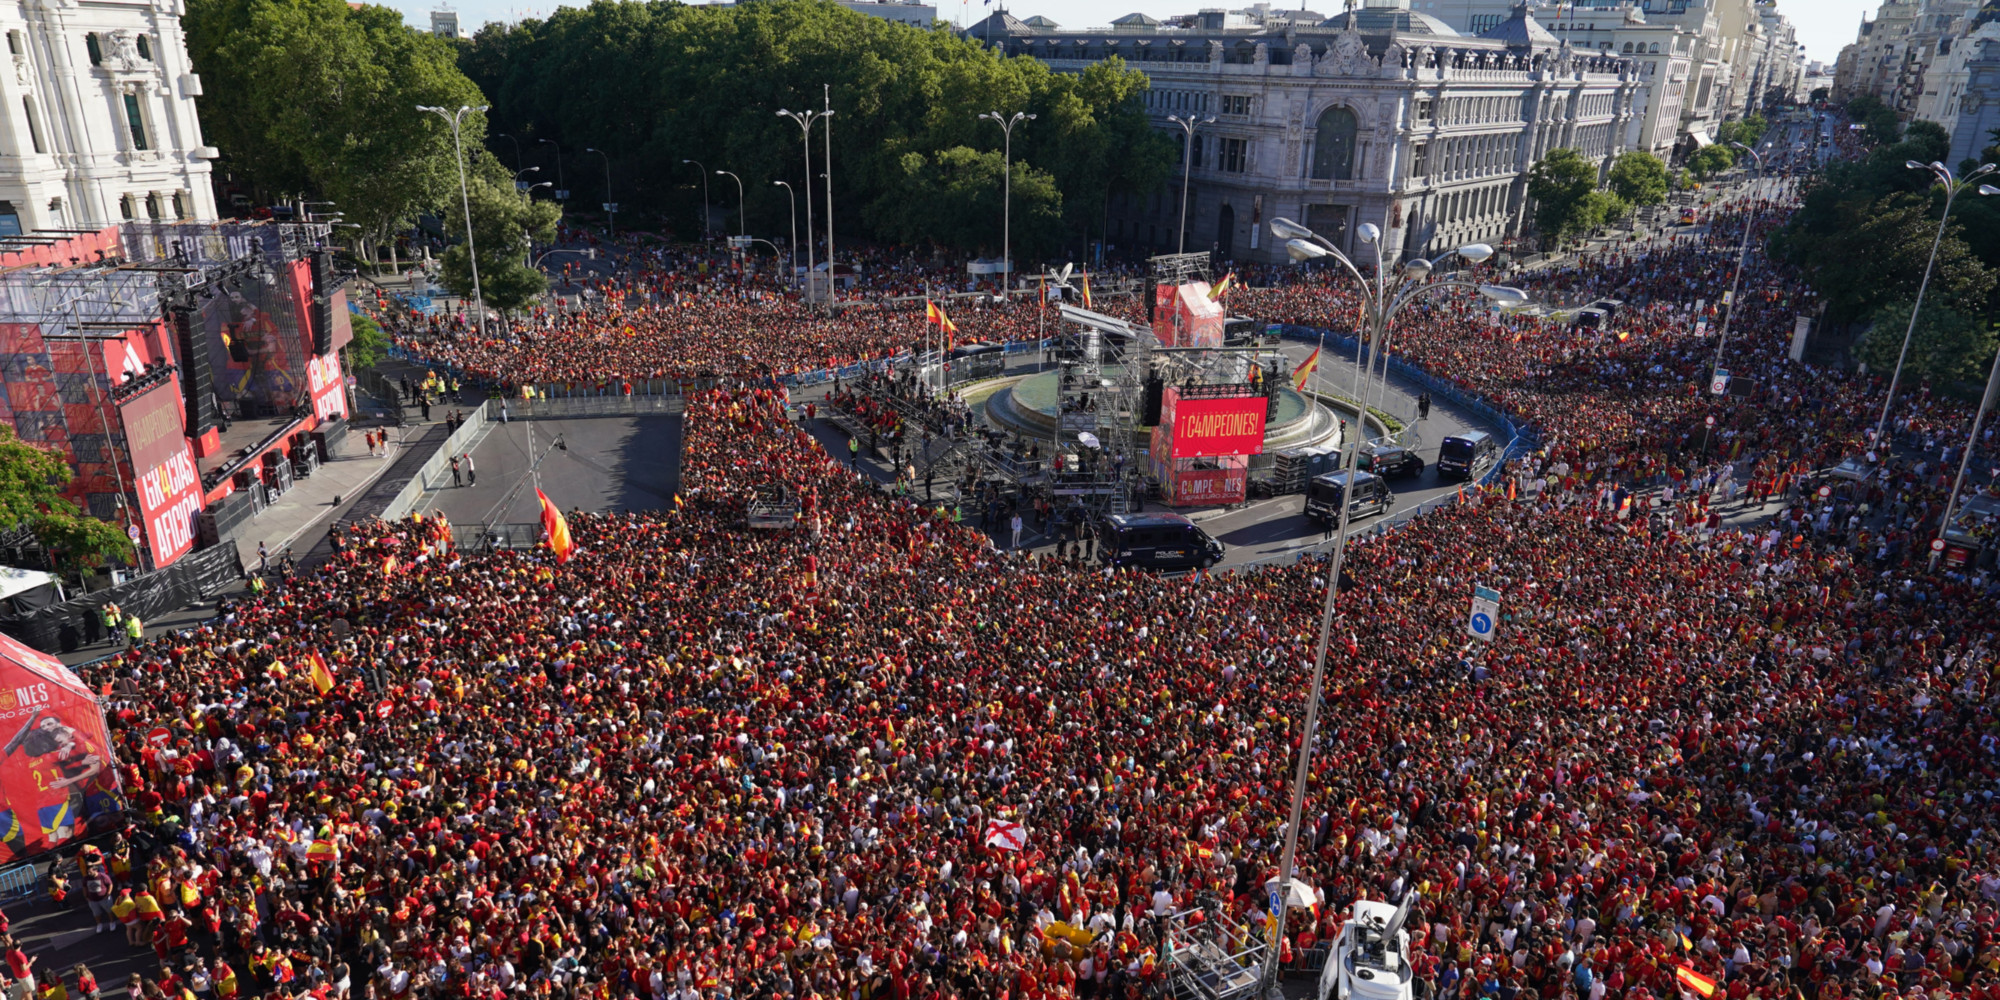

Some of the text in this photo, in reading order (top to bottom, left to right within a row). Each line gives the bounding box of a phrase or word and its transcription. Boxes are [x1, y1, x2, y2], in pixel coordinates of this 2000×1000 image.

[141, 448, 195, 512] GR4CIAS
[1222, 491, 1240, 499] 2024
[16, 682, 49, 707] NES
[18, 703, 50, 716] 2024
[99, 797, 110, 808] 10
